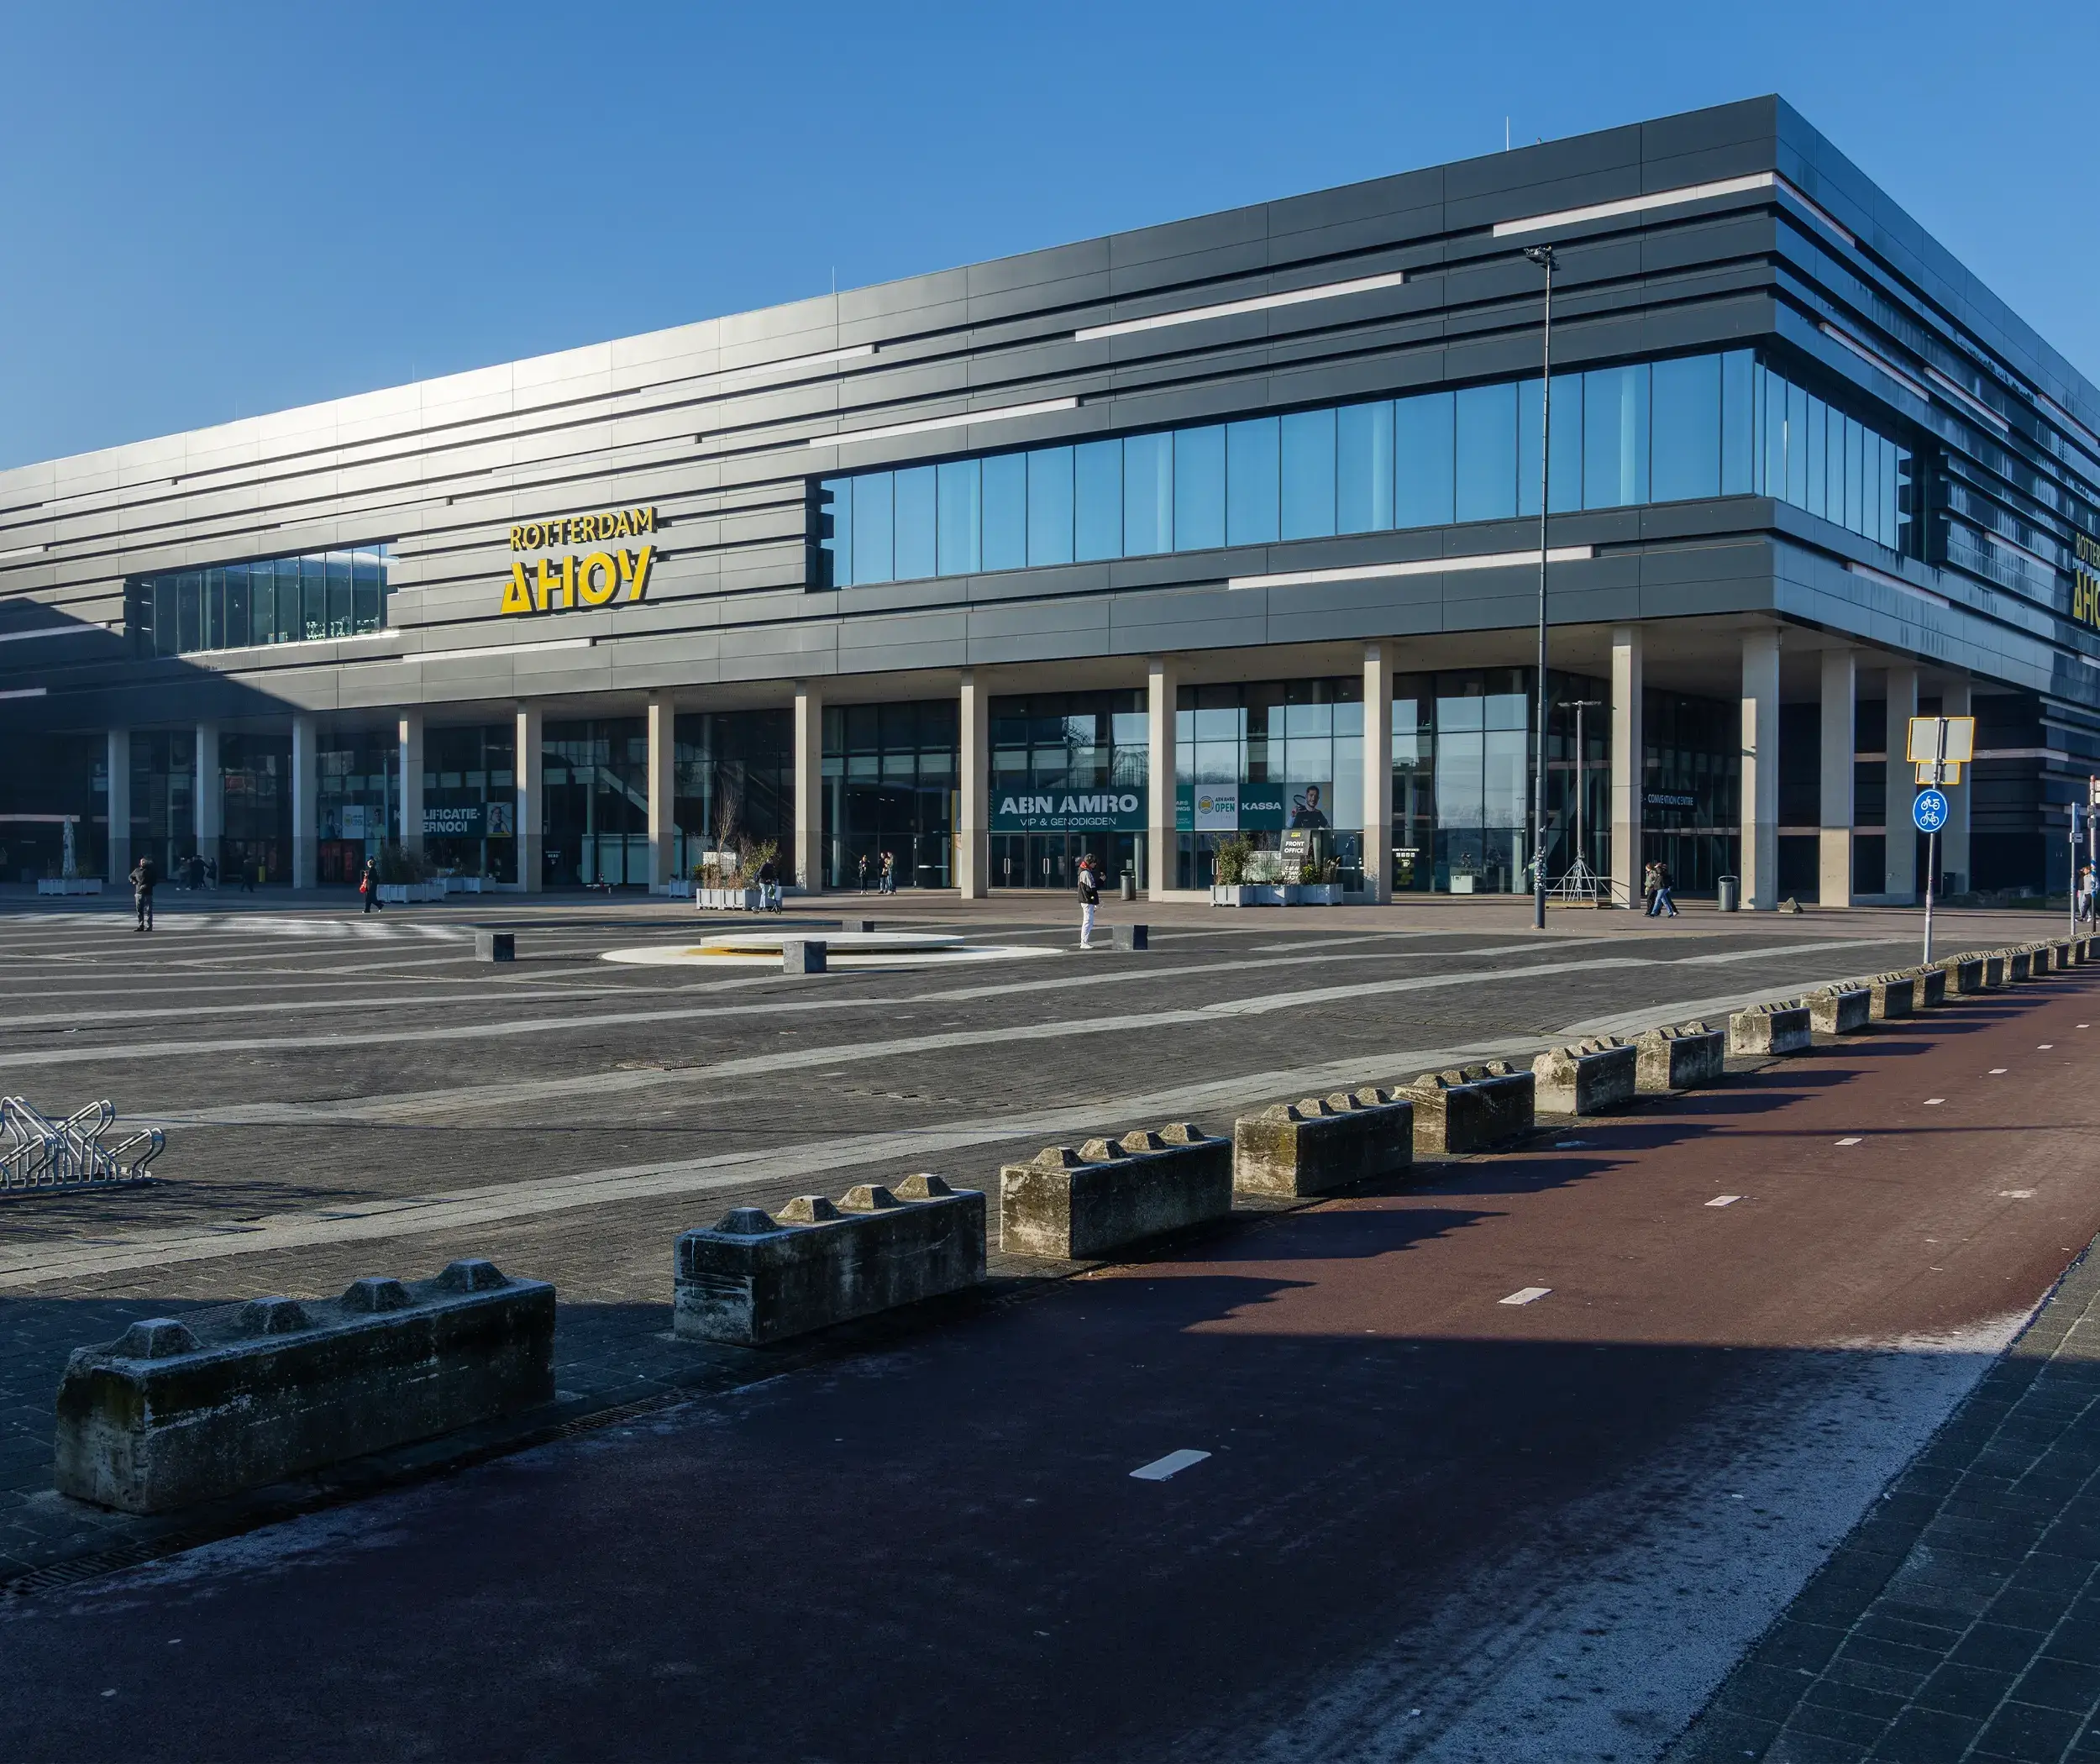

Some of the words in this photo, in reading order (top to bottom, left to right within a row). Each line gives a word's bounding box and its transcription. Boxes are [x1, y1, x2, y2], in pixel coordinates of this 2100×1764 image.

[510, 507, 654, 551] ROTTERDAM
[501, 545, 654, 614] AHOY
[999, 796, 1053, 814] ABN
[1058, 794, 1139, 813] AMRO
[1215, 803, 1236, 812] OPEN
[1242, 802, 1282, 811] KASSA
[1020, 818, 1037, 827] VIP
[1050, 817, 1116, 827] GENODIGDEN
